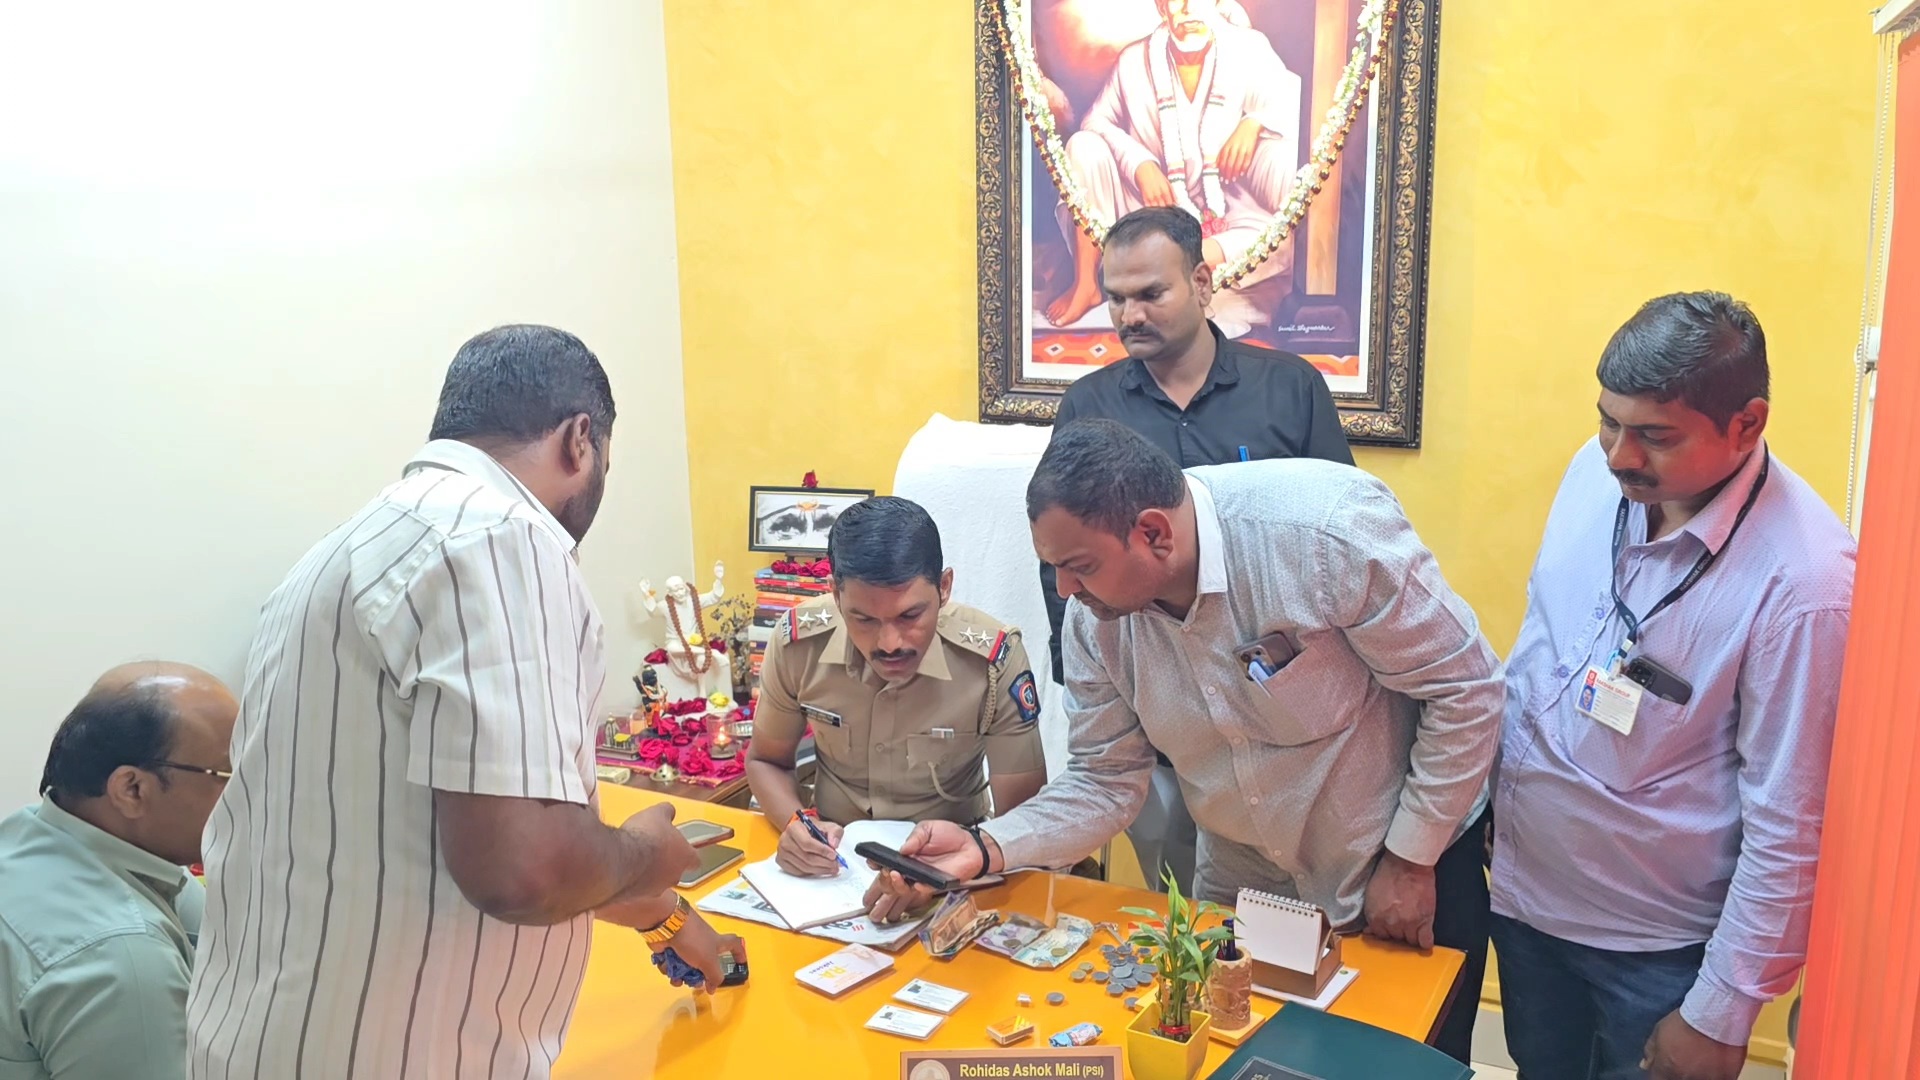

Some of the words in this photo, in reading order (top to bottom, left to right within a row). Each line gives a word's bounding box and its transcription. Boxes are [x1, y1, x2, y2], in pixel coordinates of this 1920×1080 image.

[959, 1063, 1010, 1077] Rohidas
[1012, 1062, 1052, 1077] Ashok
[1055, 1062, 1080, 1076] Mali
[1082, 1065, 1104, 1079] (PSI)
